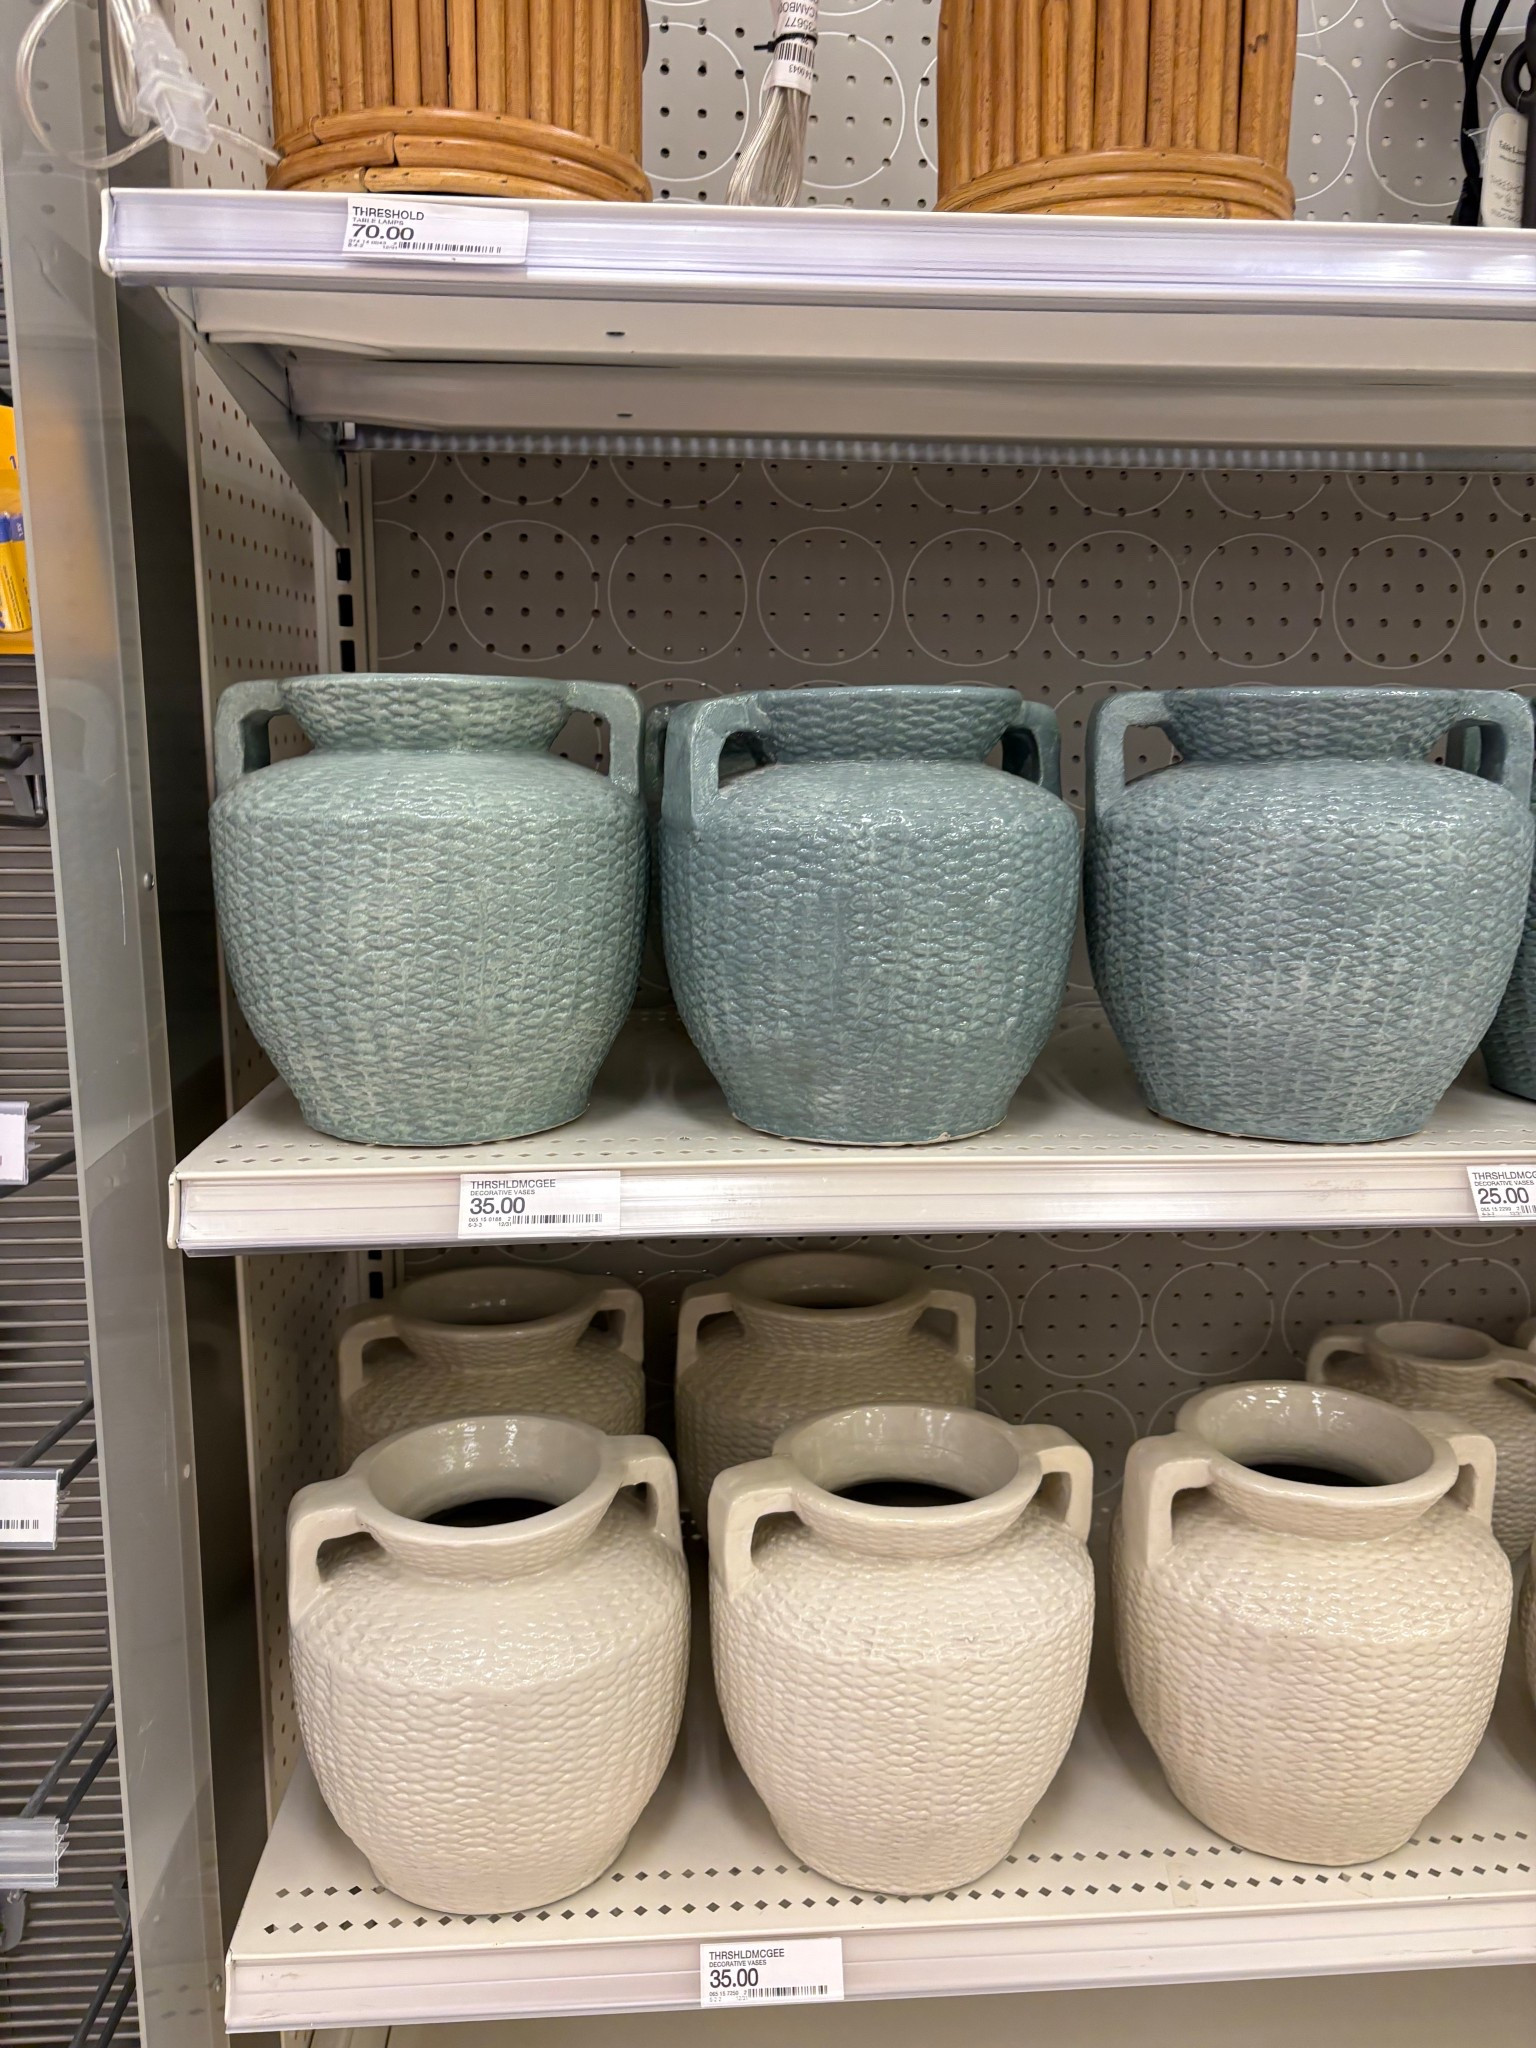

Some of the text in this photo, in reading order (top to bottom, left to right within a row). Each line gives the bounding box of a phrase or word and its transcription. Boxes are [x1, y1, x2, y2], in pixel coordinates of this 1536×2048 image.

[352, 206, 425, 221] THRESHOLD
[352, 223, 415, 241] 70.00
[470, 1179, 556, 1190] THRSHLDMCGEE
[1478, 1187, 1530, 1205] 25.00
[469, 1196, 526, 1215] 35.00
[709, 1948, 785, 1961] THRSHLDMCGEE
[709, 1967, 759, 1989] 35.00
